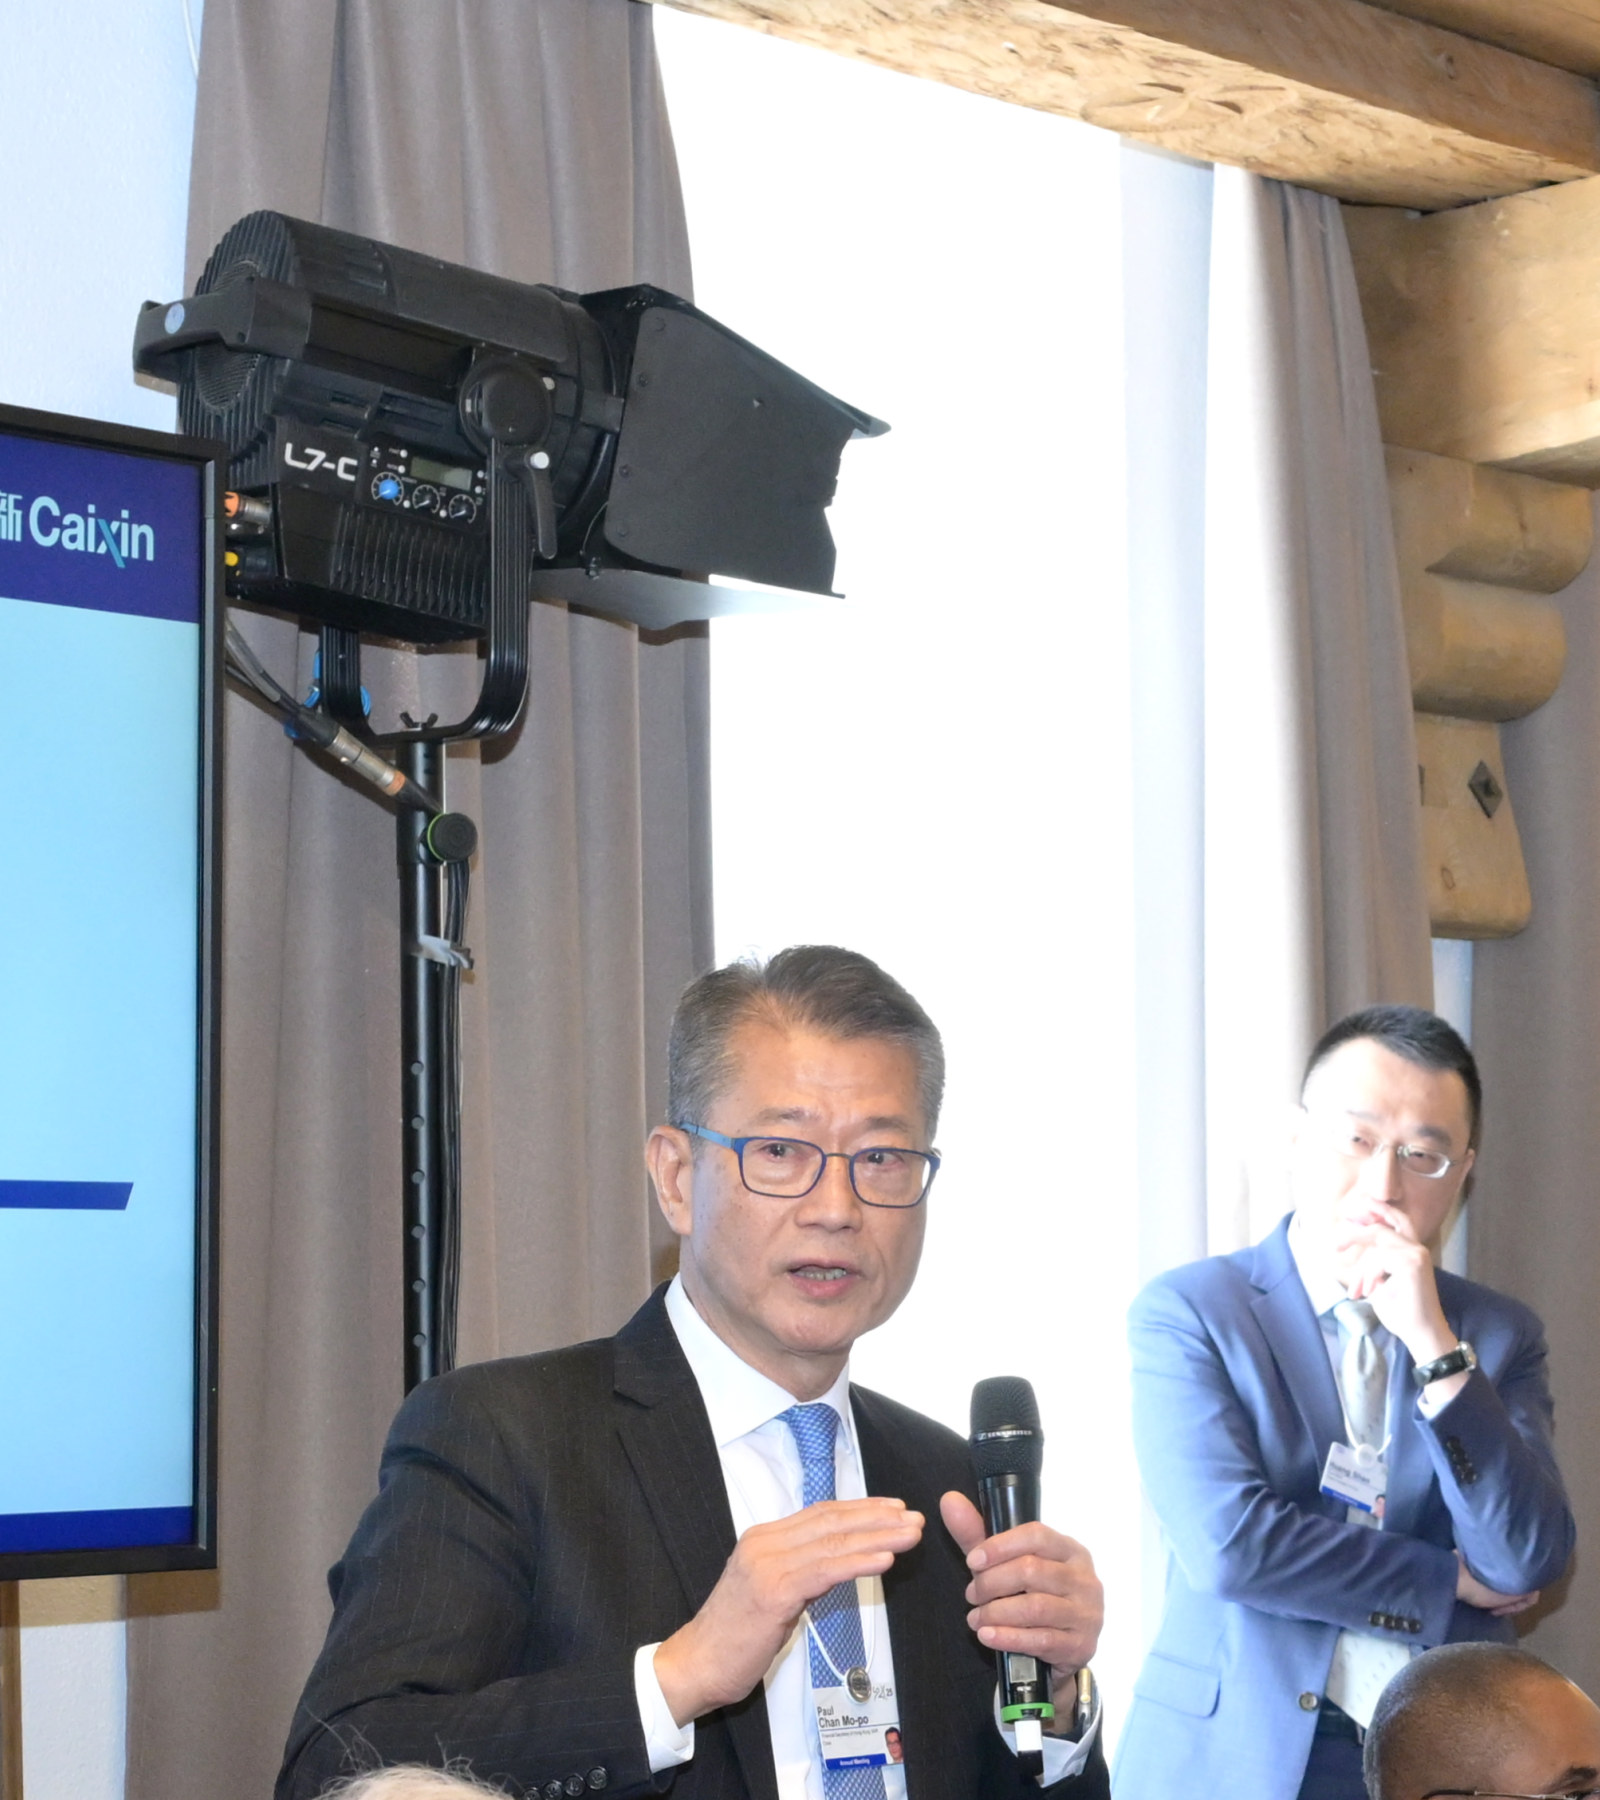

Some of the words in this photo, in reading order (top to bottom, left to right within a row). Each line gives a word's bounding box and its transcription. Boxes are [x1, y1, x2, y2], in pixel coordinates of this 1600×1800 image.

[284, 442, 358, 482] L7-C
[29, 496, 154, 568] Caixin
[817, 1705, 834, 1716] Paul
[818, 1717, 840, 1728] Chan
[841, 1715, 869, 1728] Mo-po
